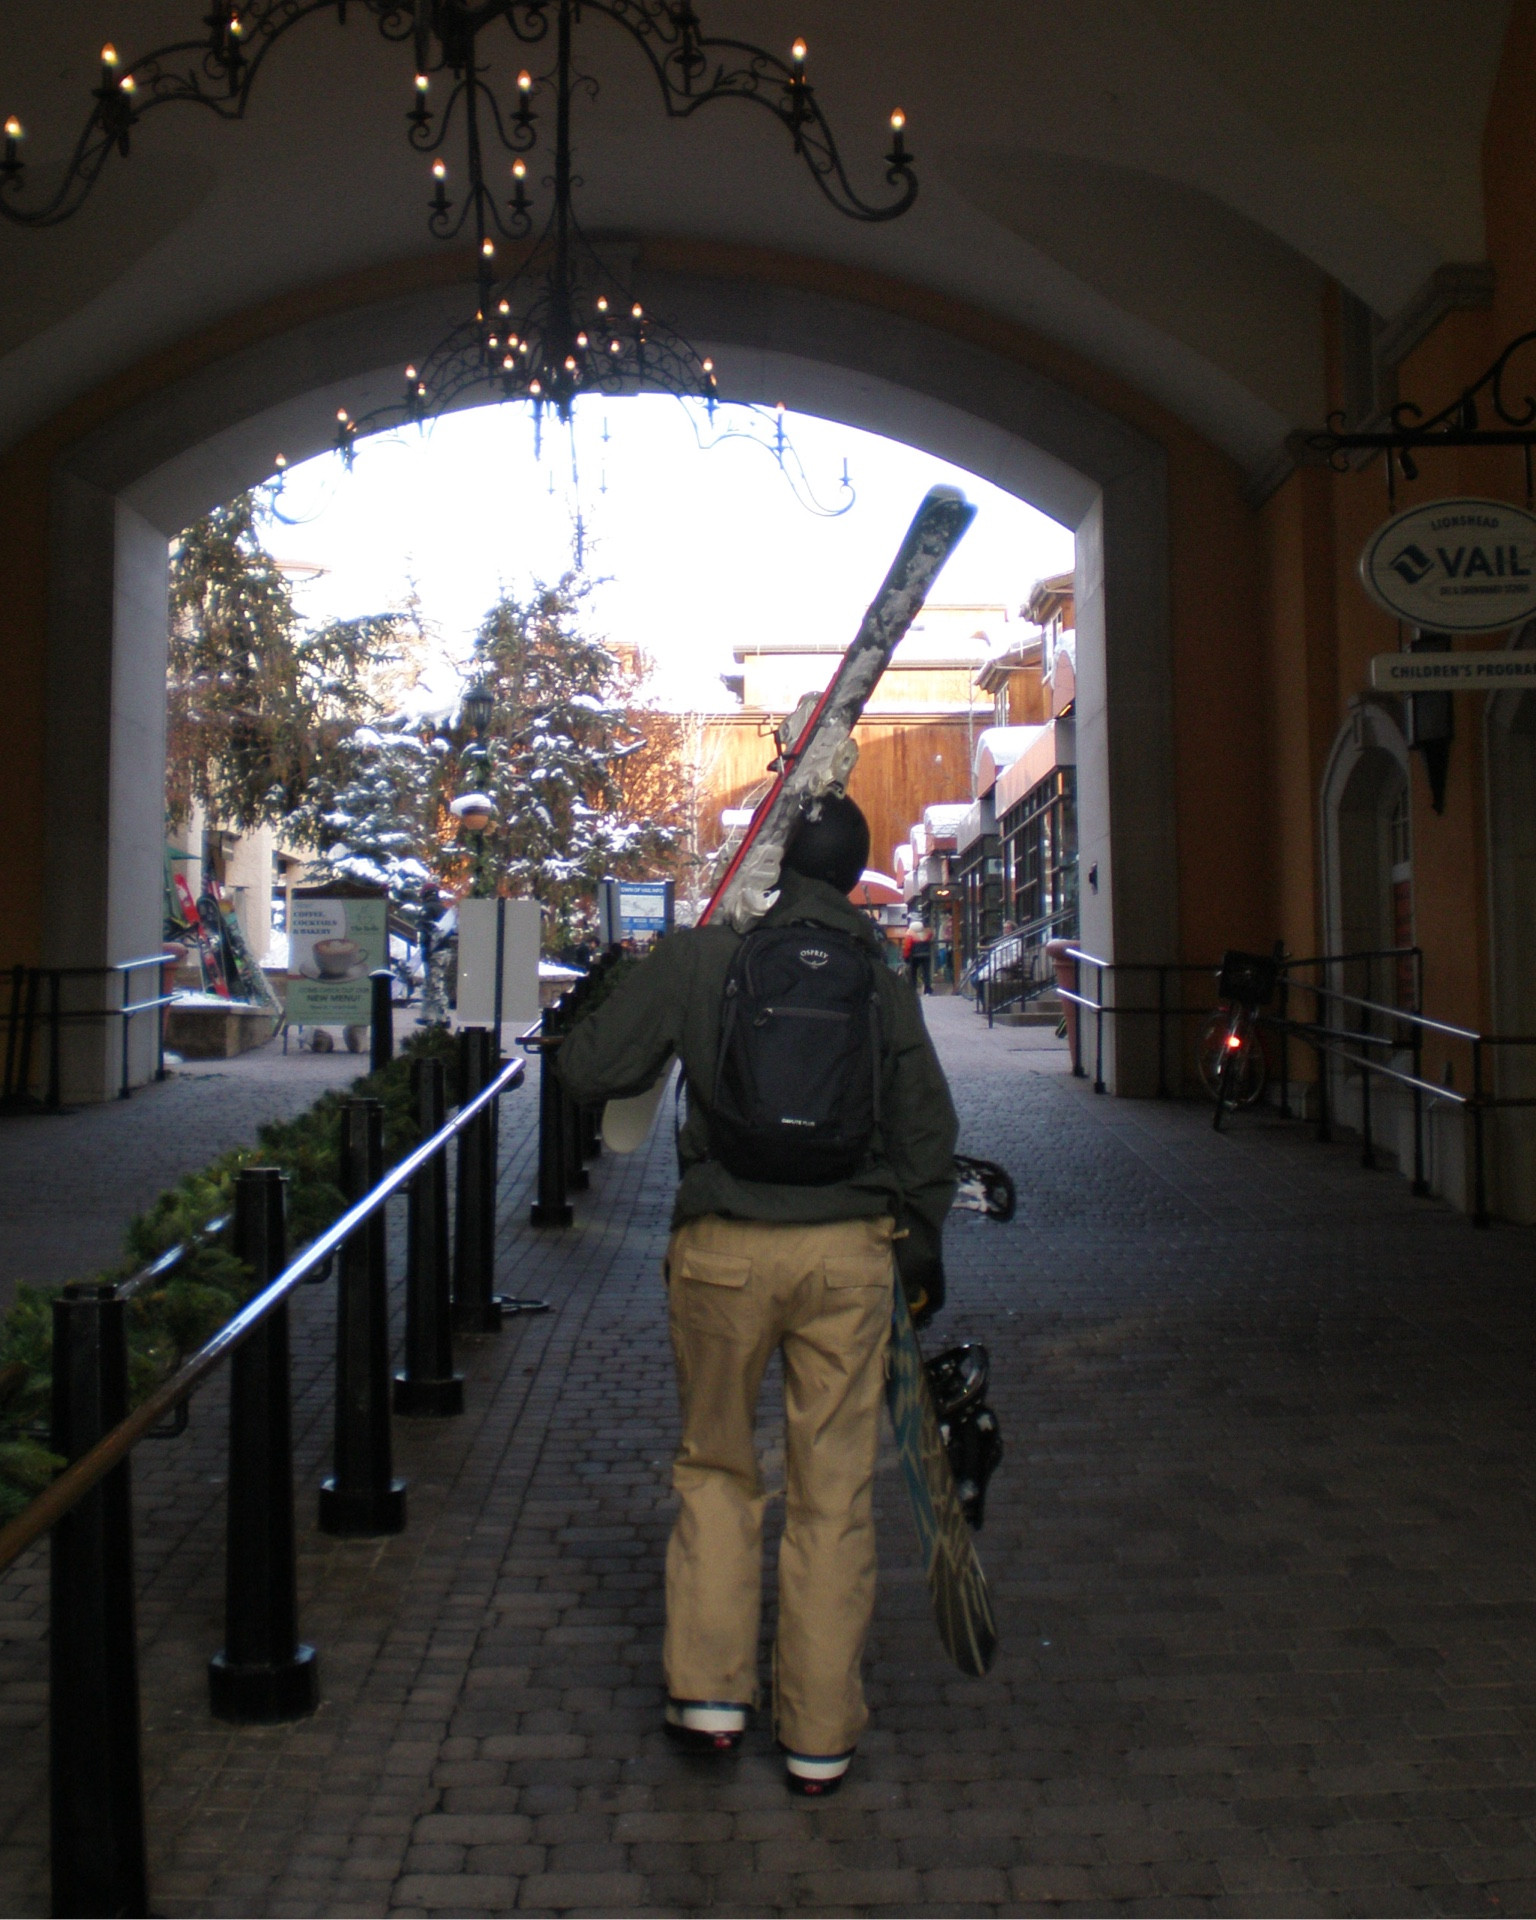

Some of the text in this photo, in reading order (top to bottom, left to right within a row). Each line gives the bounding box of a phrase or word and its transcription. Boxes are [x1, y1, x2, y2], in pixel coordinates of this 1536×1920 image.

[1431, 515, 1500, 531] LIONSHEAD
[1436, 545, 1532, 578] VAIL
[1391, 664, 1473, 678] CHILDREN'S
[800, 949, 829, 959] OSPREY
[306, 994, 328, 1002] NEW
